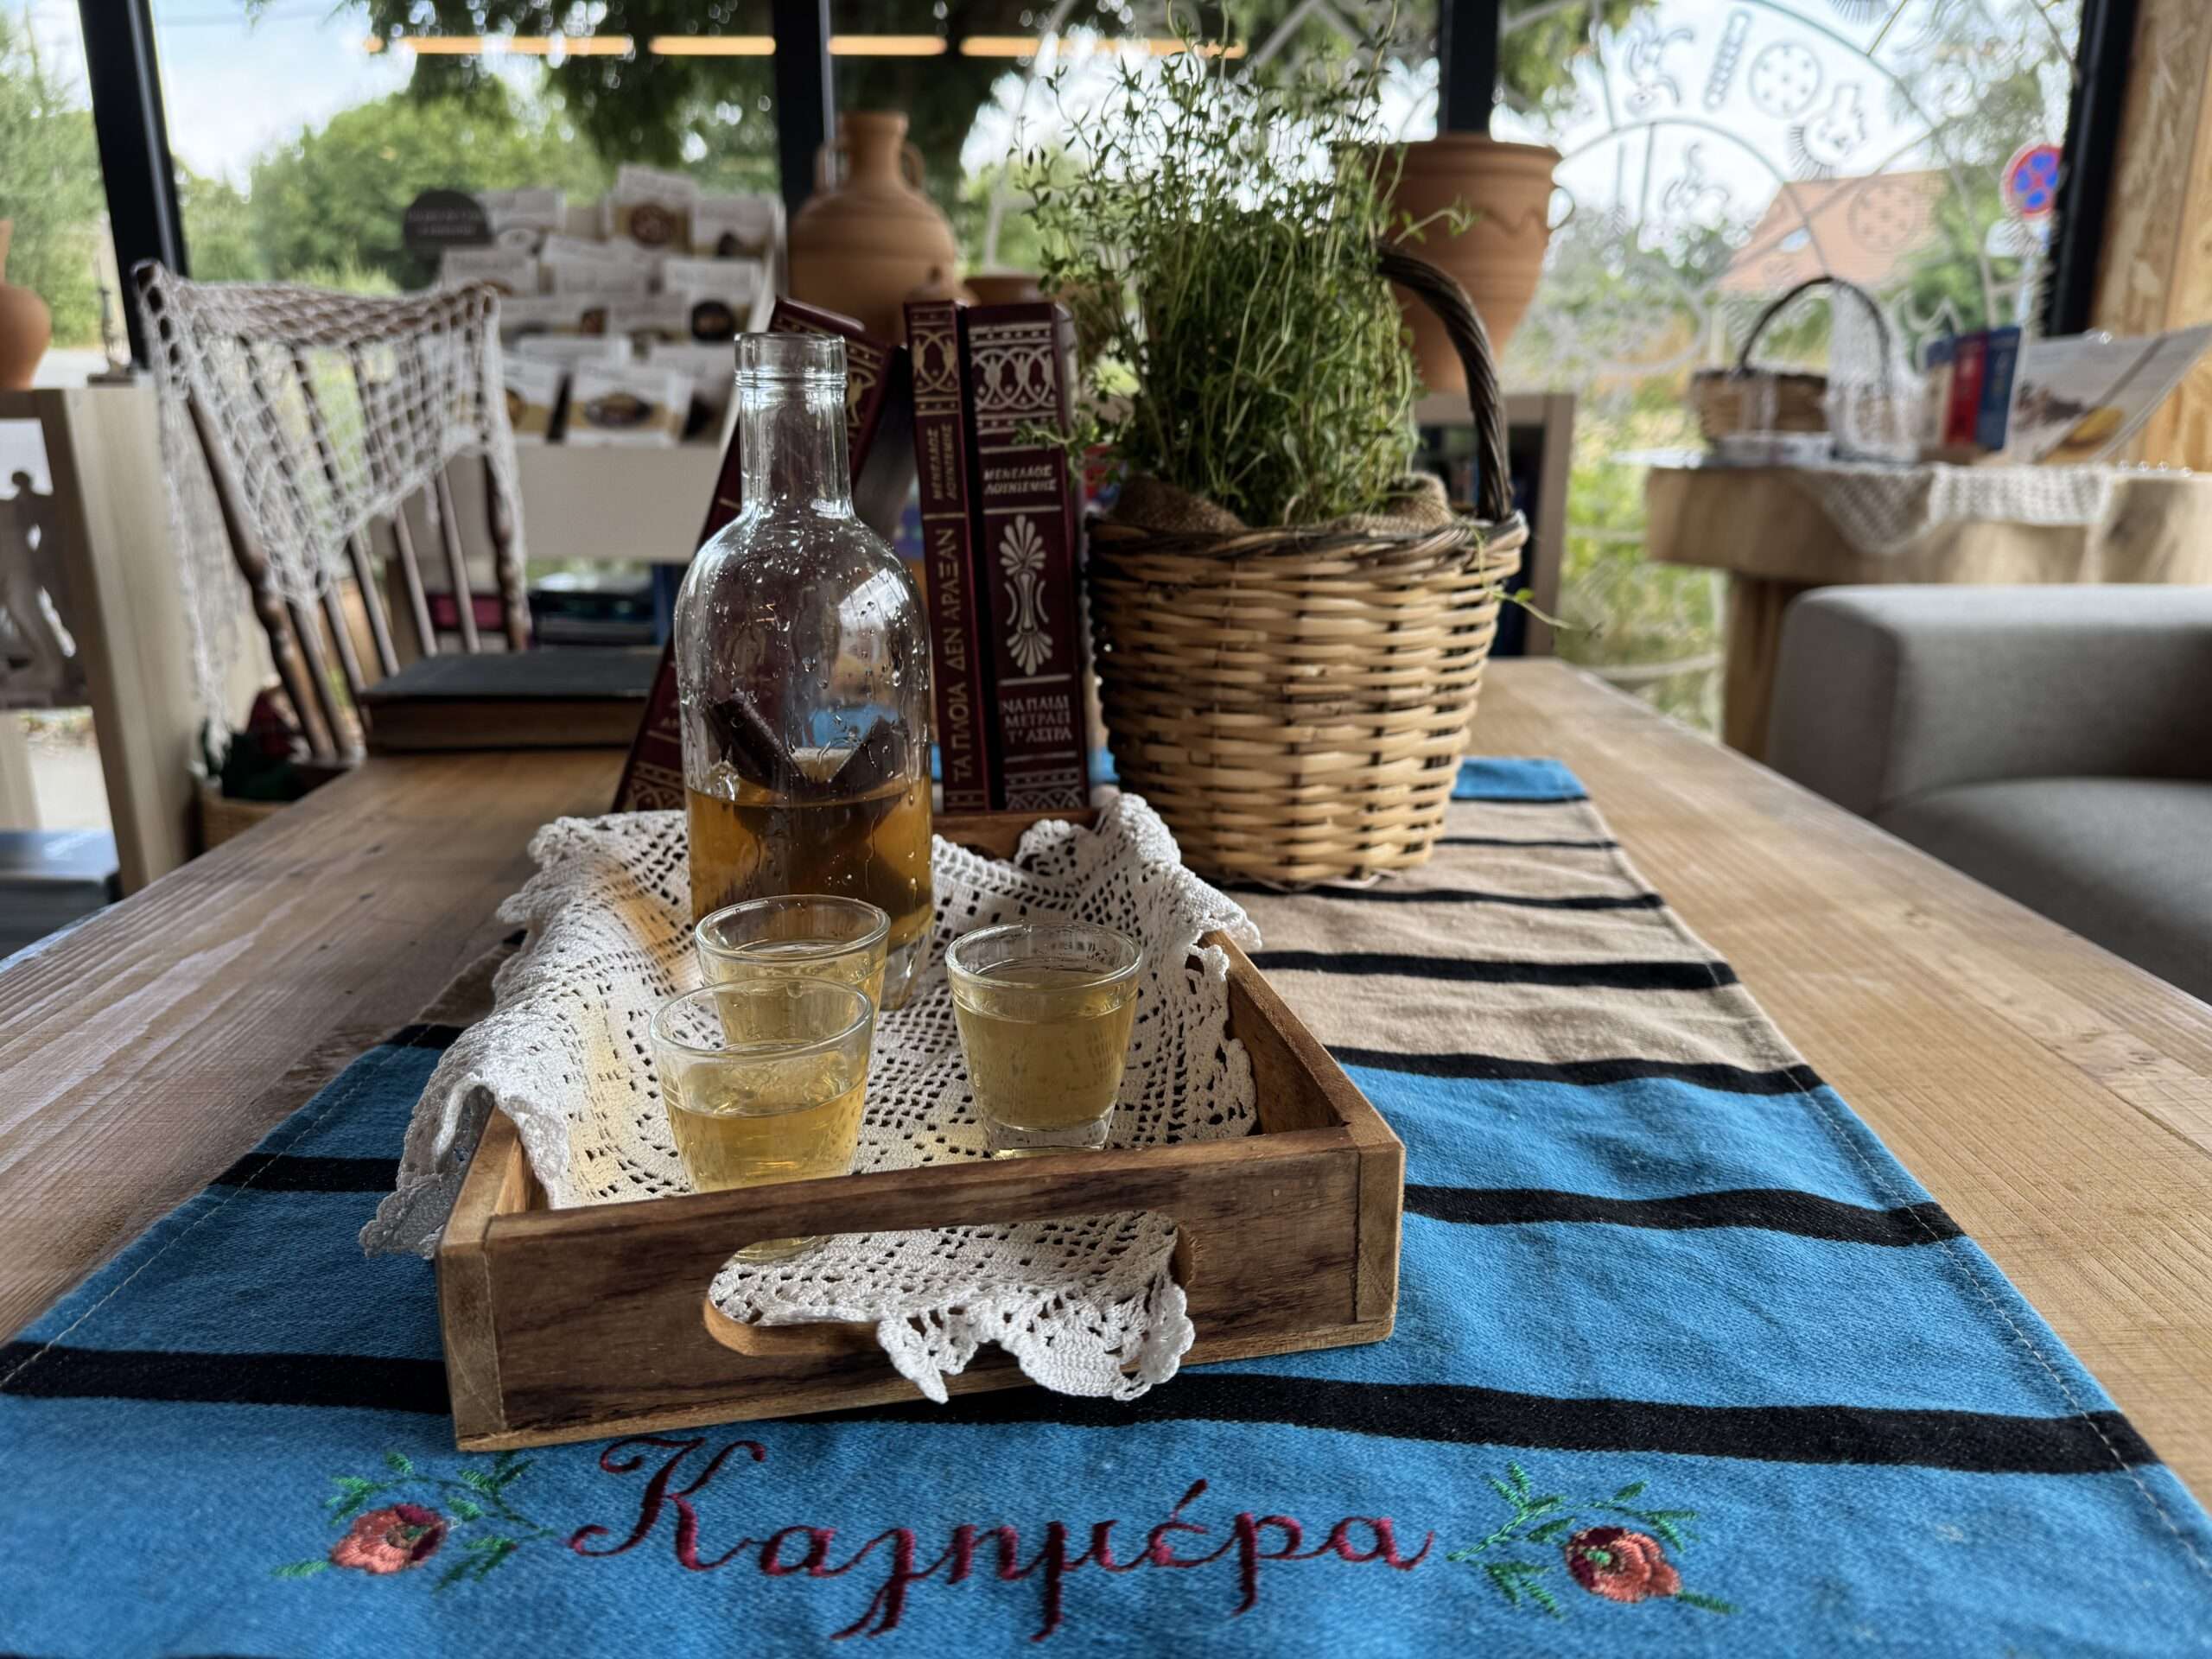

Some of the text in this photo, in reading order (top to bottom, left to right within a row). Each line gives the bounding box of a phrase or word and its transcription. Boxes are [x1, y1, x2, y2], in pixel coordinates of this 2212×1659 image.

[936, 528, 972, 782] ΤΑ ΠΛΟΙΑ ΔΕΝ ΑΡΑΞΑΝ
[1026, 695, 1069, 711] ΠΑΙΔΙ
[1005, 711, 1071, 728] ΜΕΤΡΑΕΙ
[566, 1437, 1433, 1641] Καλημέρα
